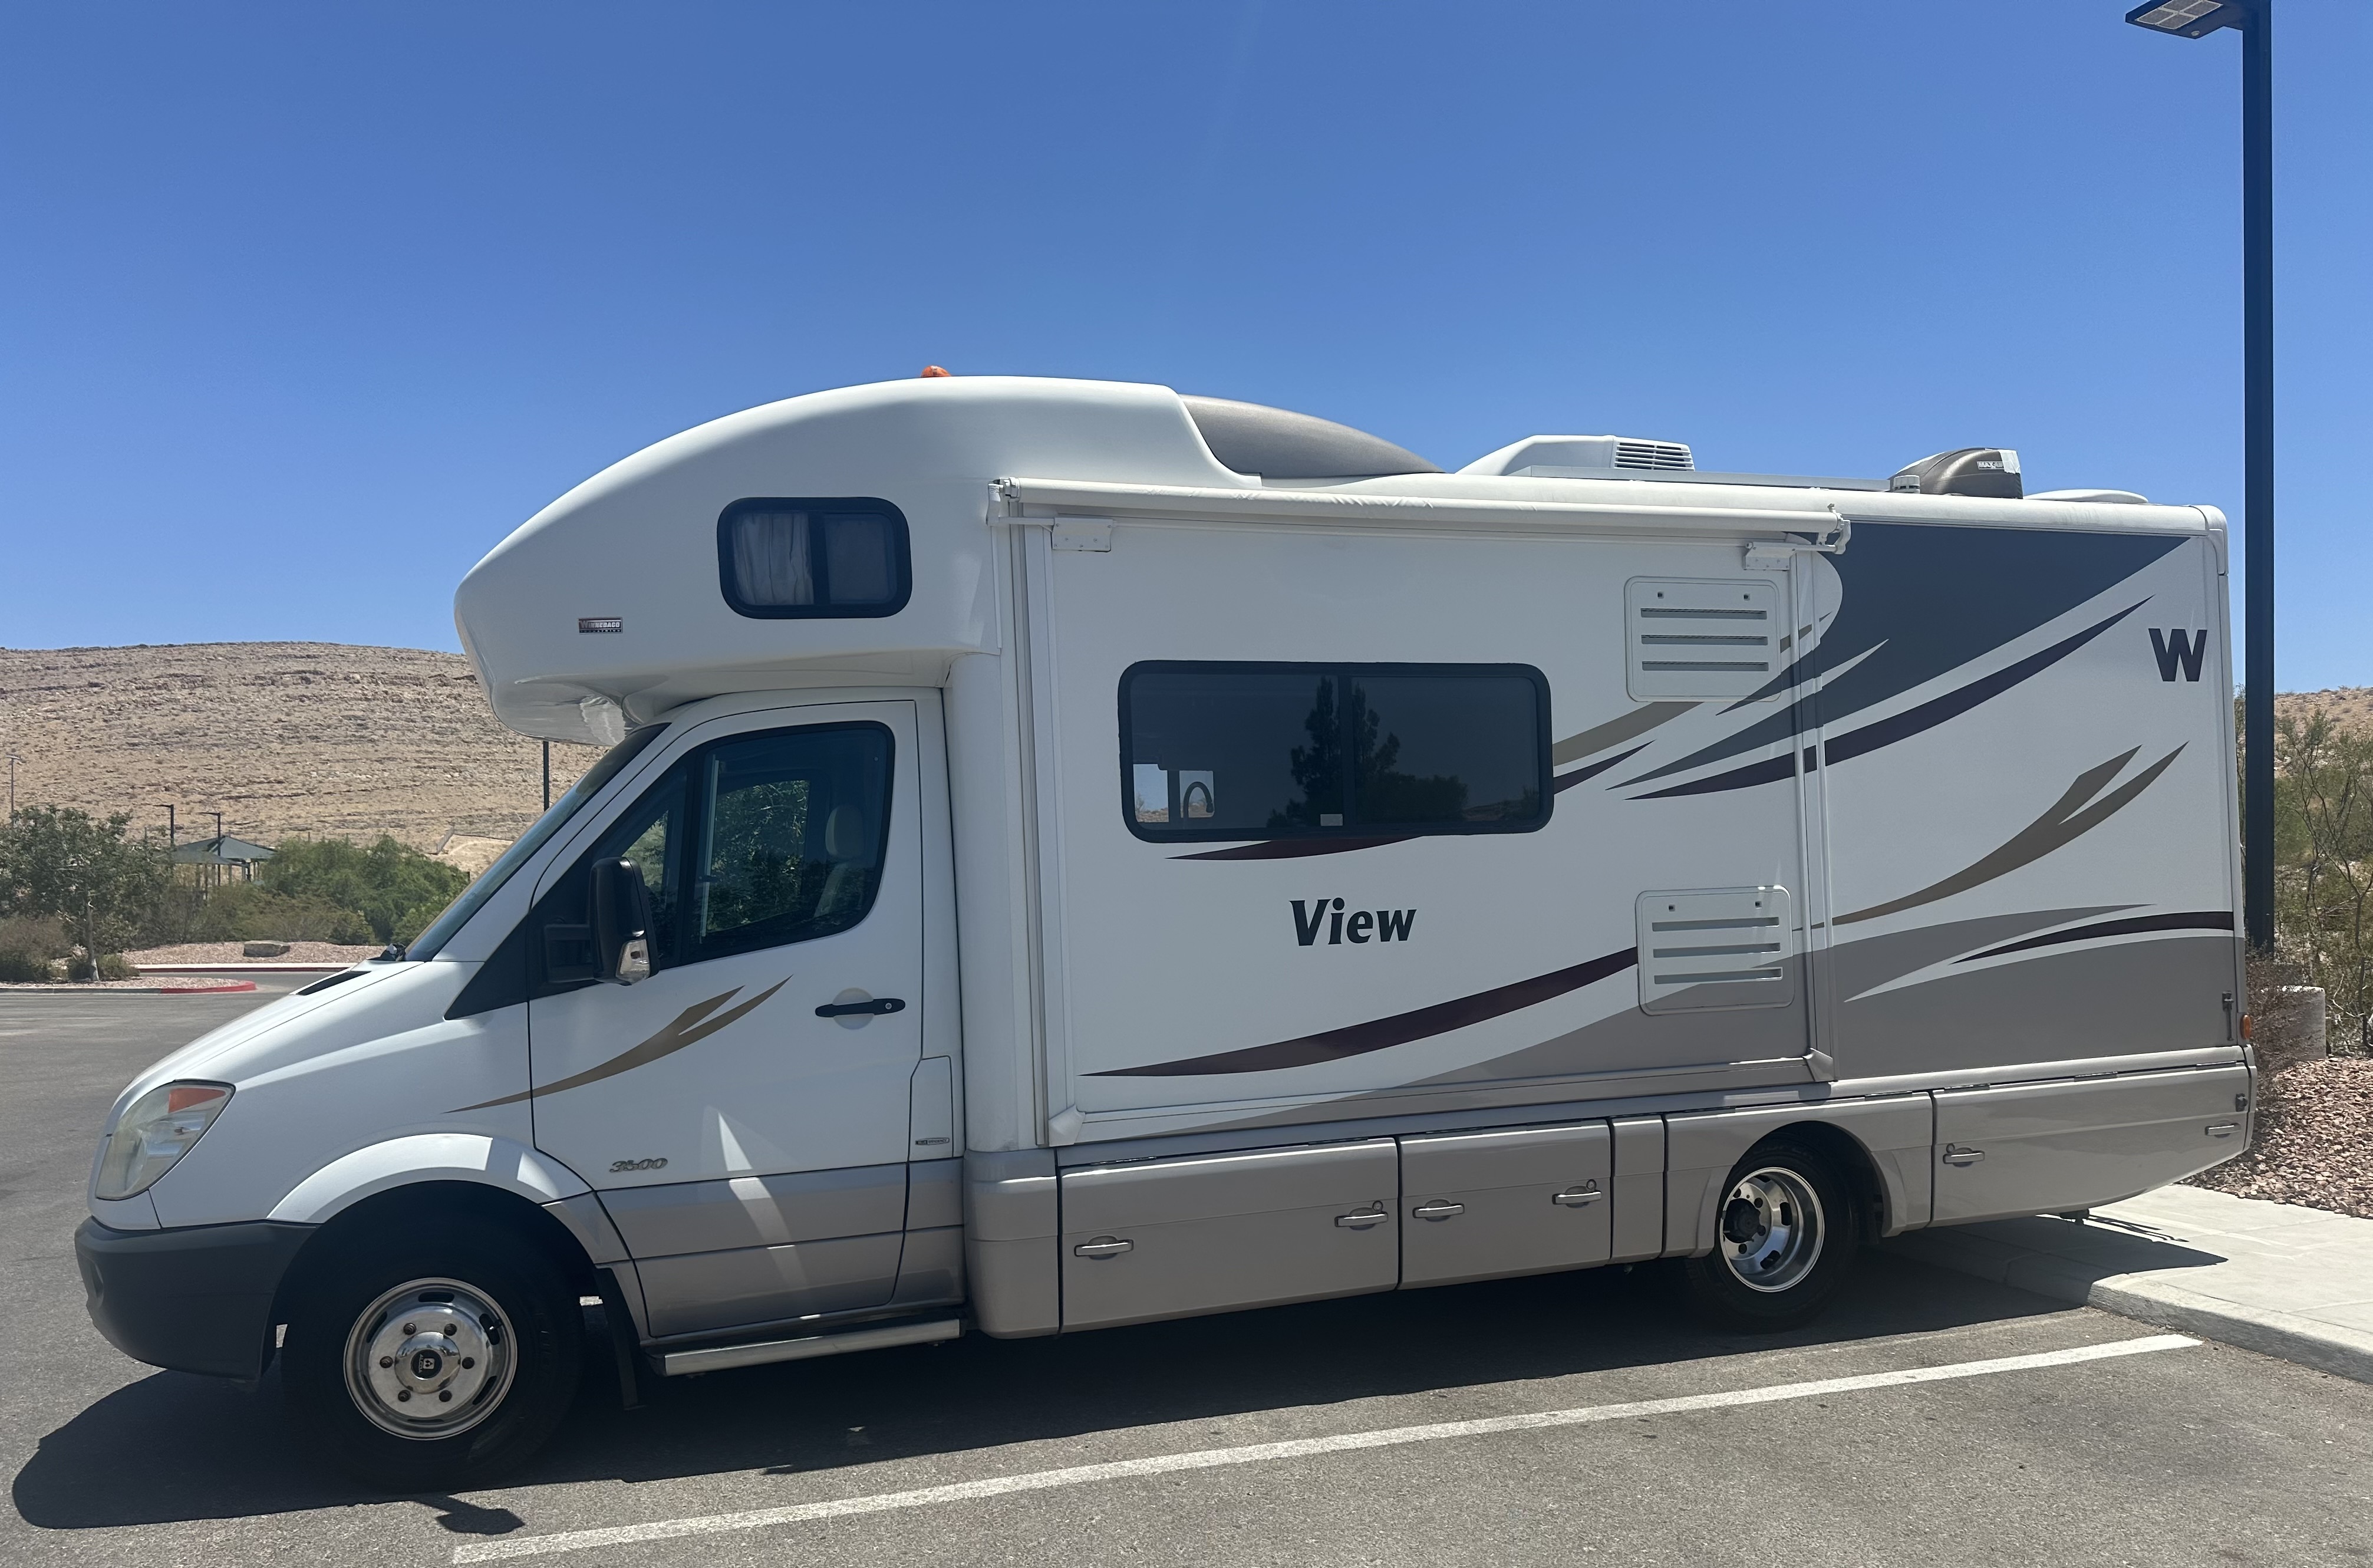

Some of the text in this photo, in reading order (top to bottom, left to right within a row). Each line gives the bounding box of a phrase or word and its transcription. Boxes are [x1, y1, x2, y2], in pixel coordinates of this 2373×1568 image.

[2148, 628, 2207, 681] W
[1288, 897, 1417, 946] View
[609, 1158, 668, 1172] 3500
